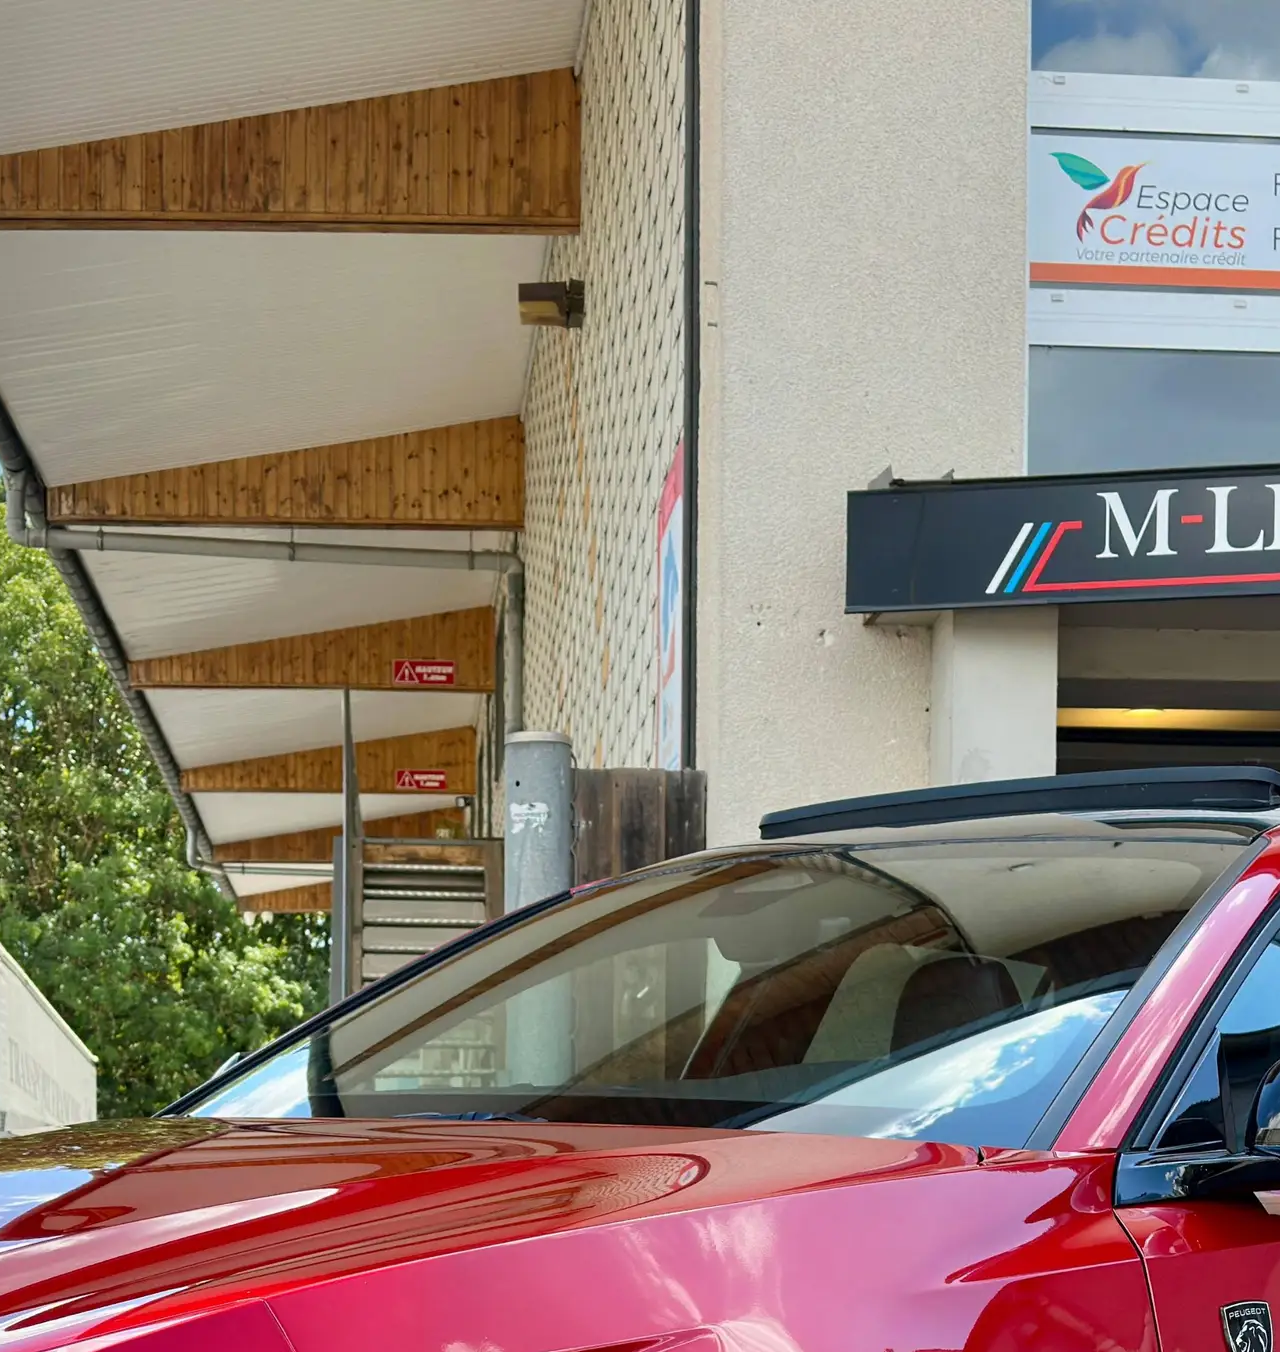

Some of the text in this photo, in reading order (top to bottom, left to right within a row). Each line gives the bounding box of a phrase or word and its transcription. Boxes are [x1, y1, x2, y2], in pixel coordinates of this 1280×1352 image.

[1136, 185, 1249, 214] Espace
[1100, 212, 1247, 251] Crédits
[1076, 247, 1247, 267] Votre partenaire crédit
[1228, 1308, 1266, 1320] PEUGEOT
